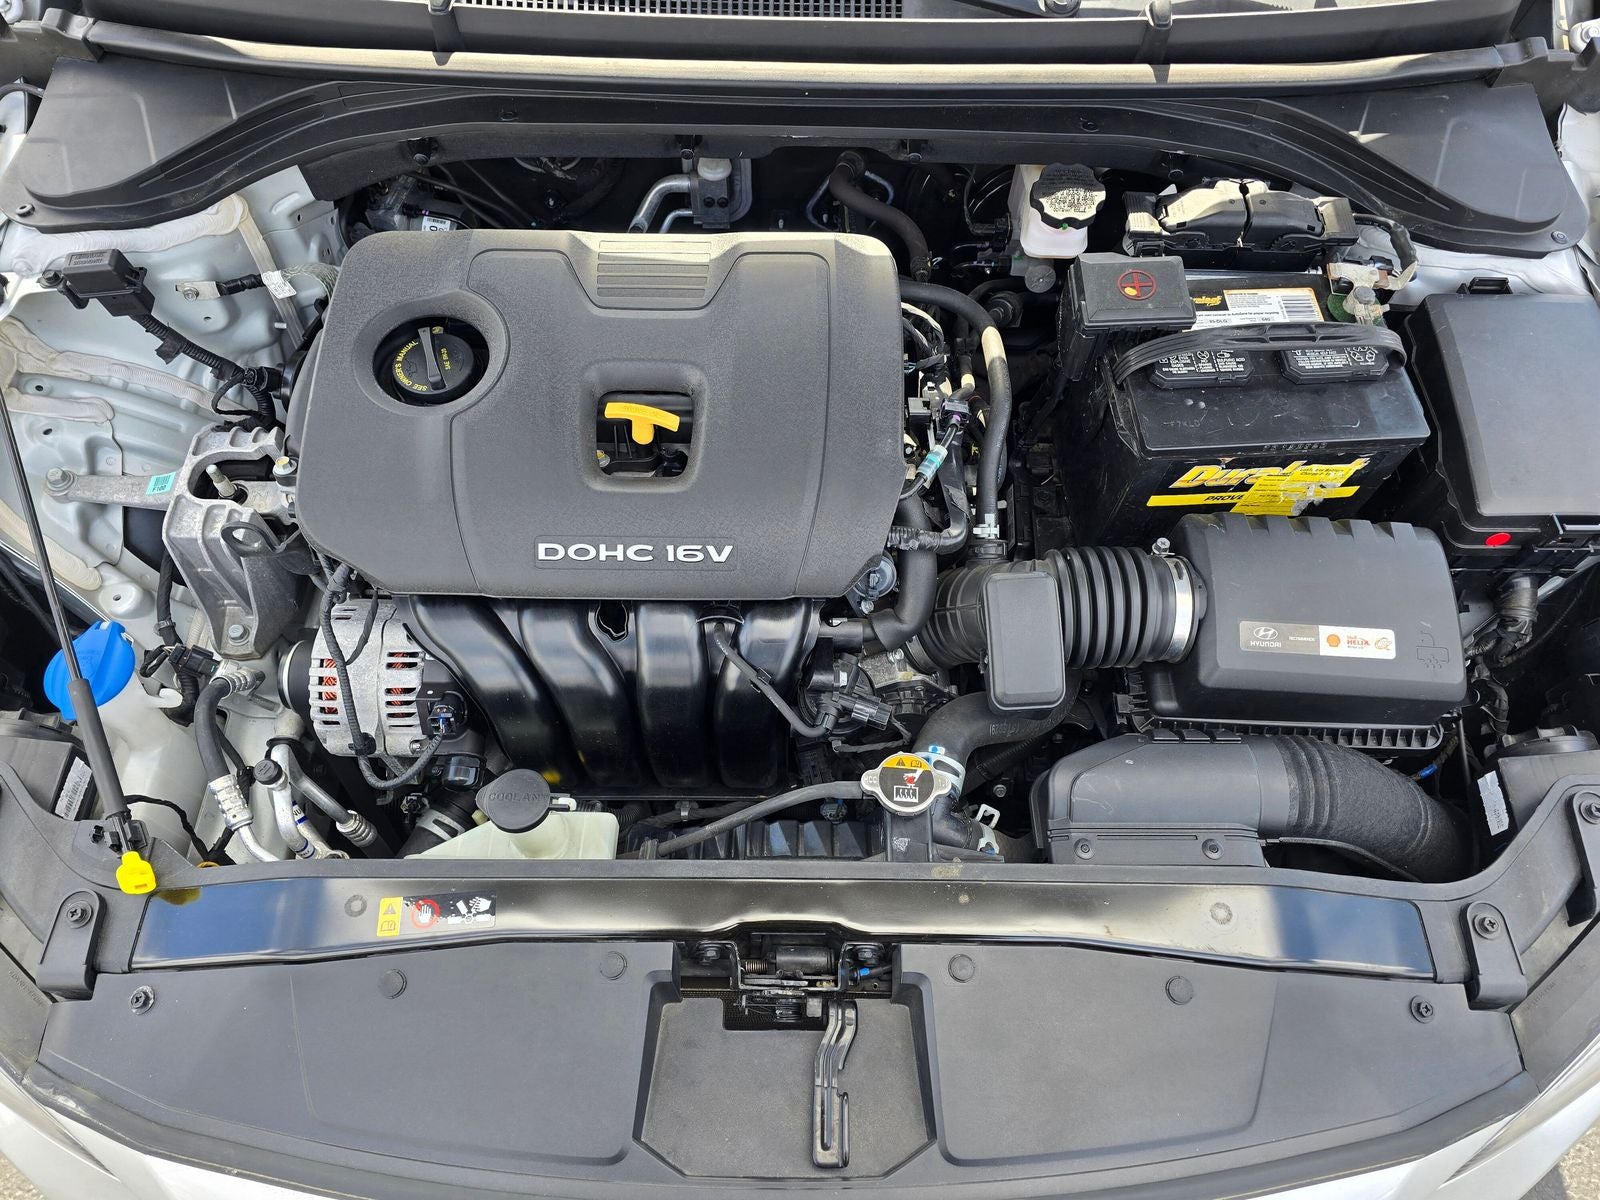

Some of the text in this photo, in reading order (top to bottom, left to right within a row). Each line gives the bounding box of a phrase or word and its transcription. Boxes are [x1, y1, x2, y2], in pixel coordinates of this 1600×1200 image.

[396, 340, 419, 362] MANUAL
[412, 383, 428, 391] SEE
[537, 542, 734, 563] DOHC 16V
[1250, 640, 1282, 648] HYUNDAI
[1347, 638, 1370, 646] HELIX
